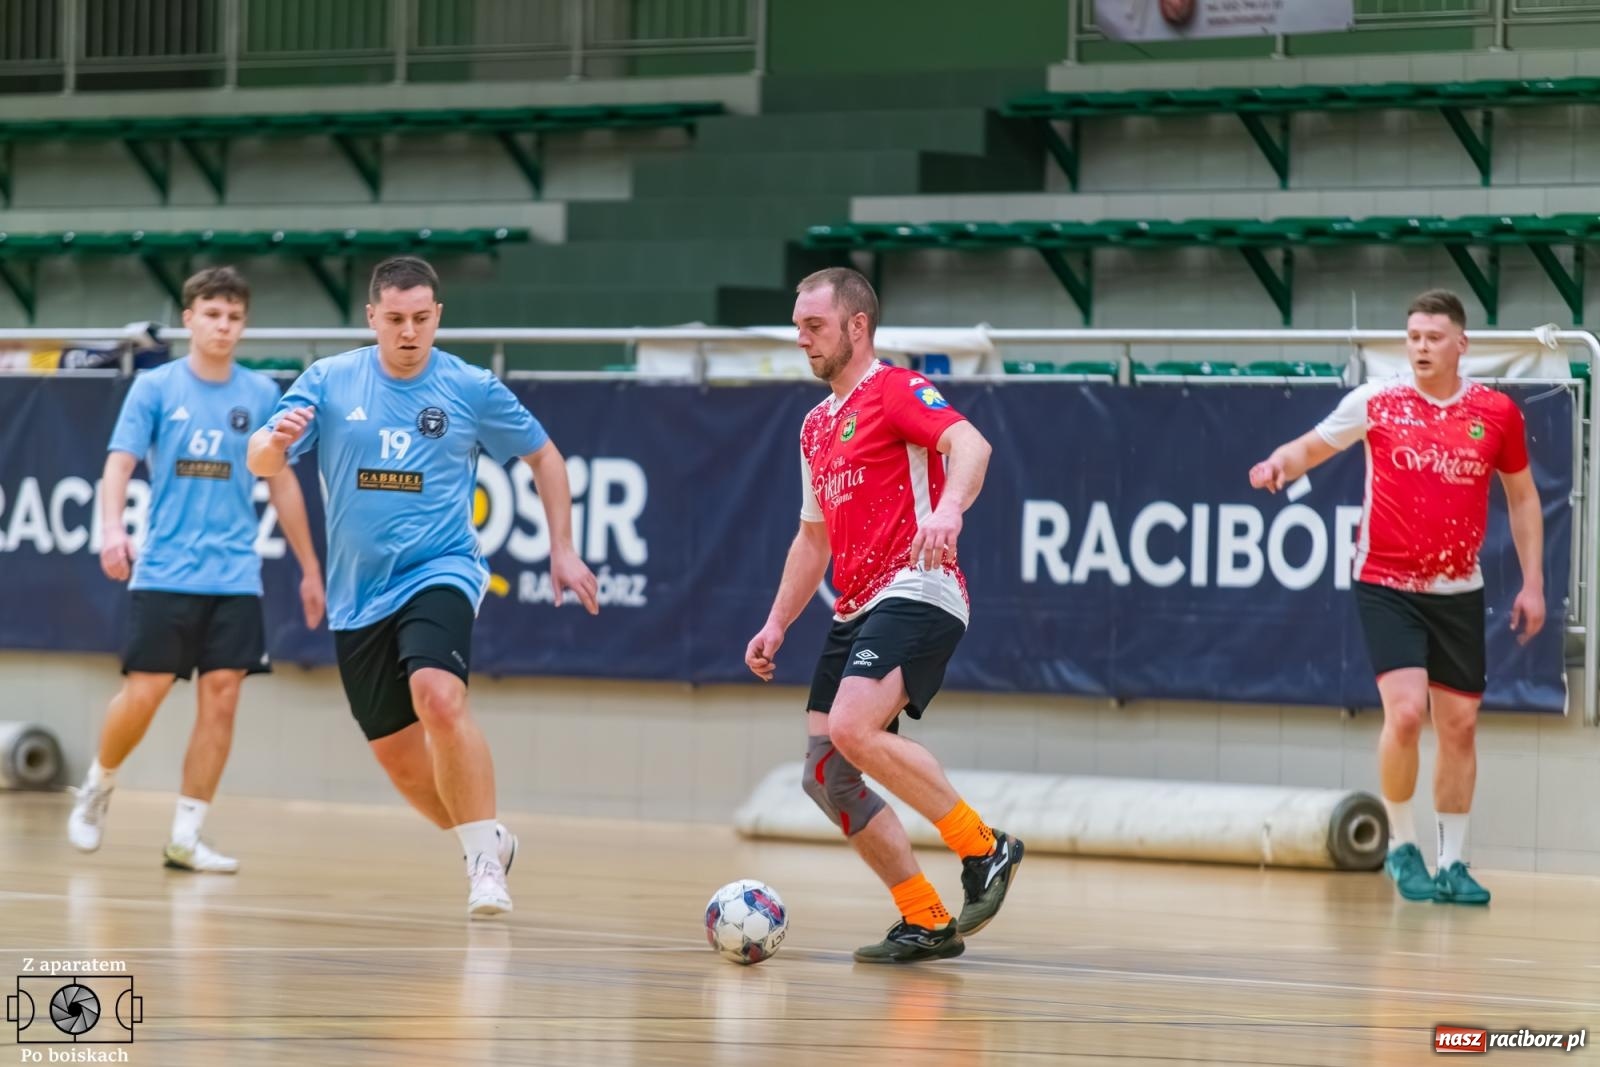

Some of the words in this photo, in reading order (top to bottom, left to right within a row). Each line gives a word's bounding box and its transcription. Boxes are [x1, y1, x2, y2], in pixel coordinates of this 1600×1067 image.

[188, 429, 224, 457] 67
[379, 430, 412, 460] 19
[360, 472, 420, 484] GABRIEL
[1021, 474, 1362, 590] RACIBÓR
